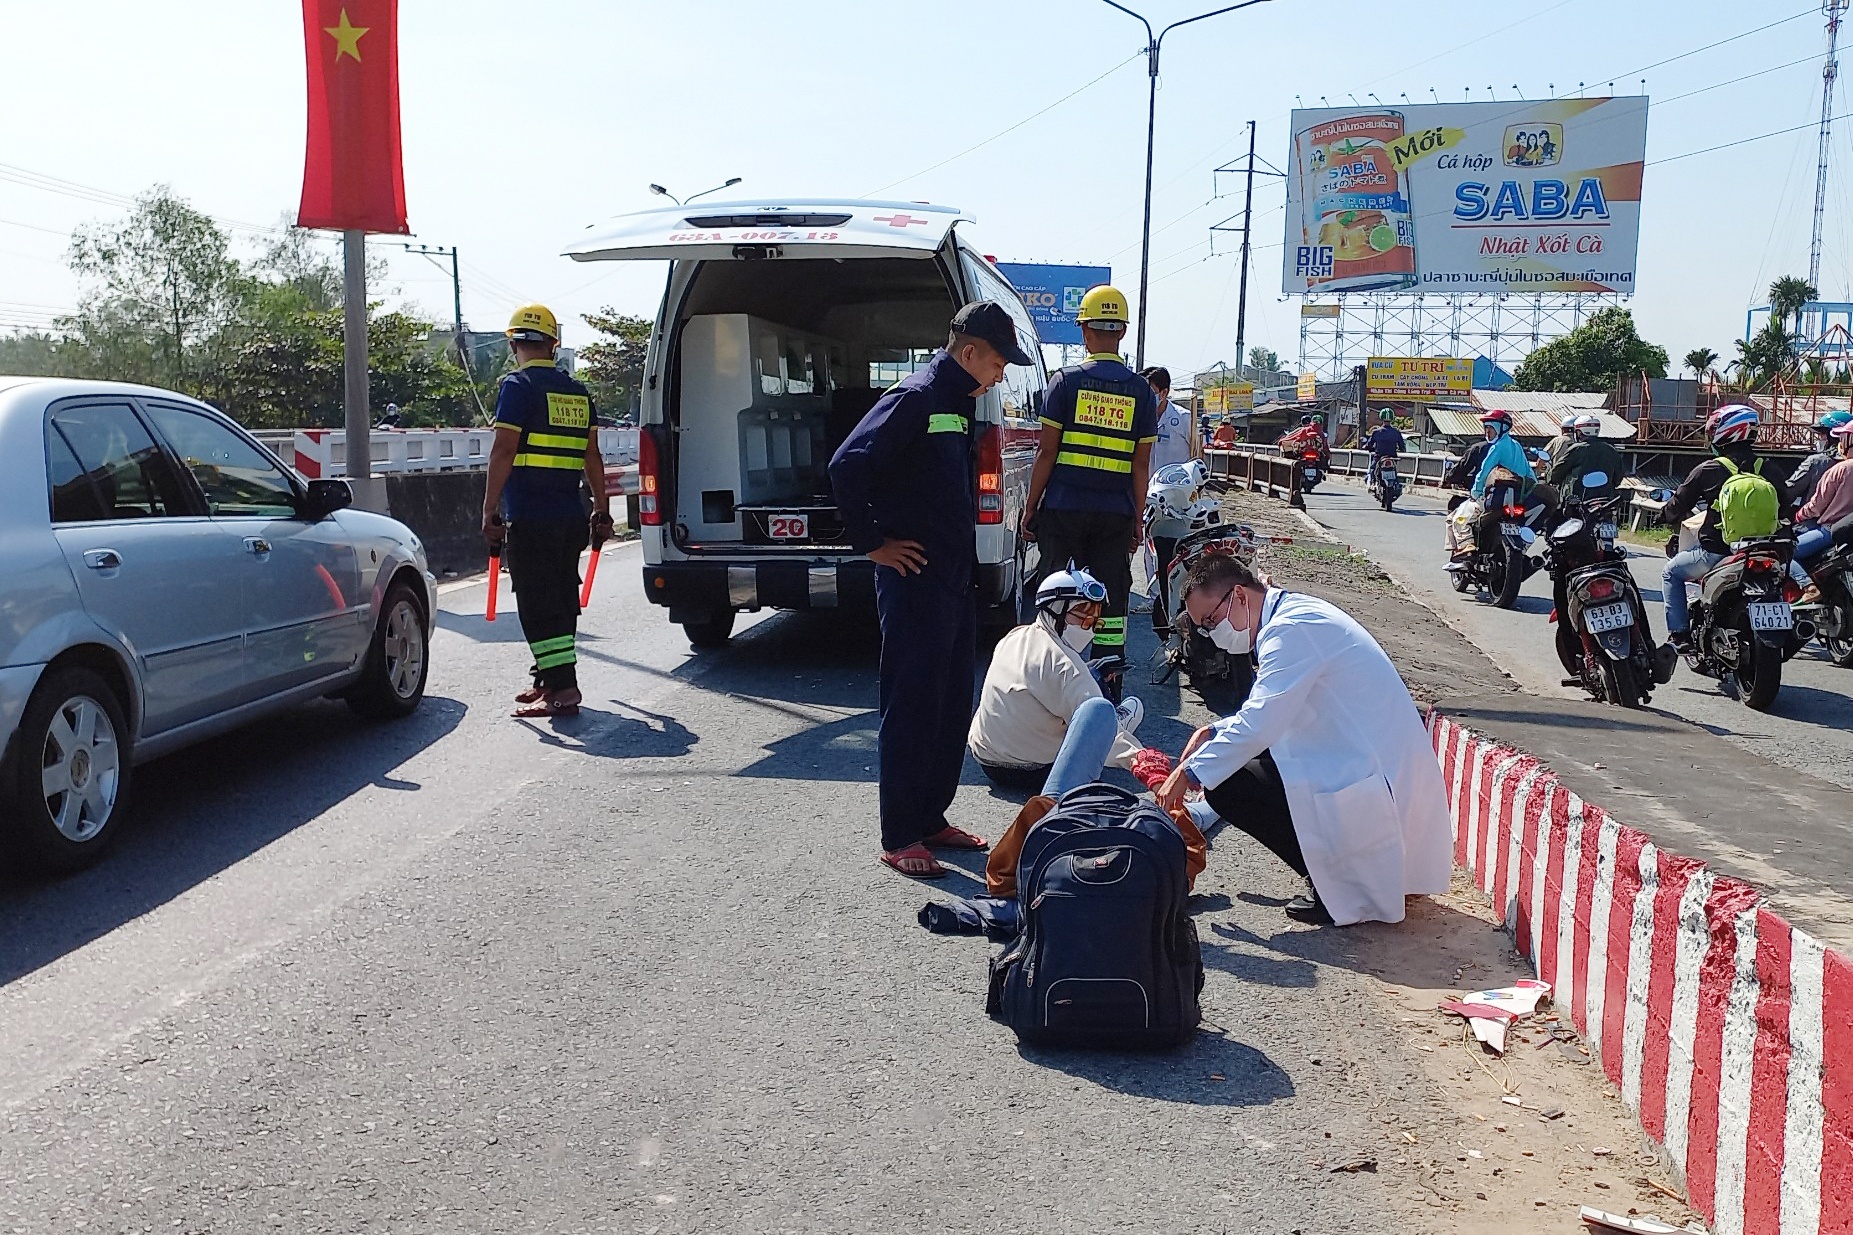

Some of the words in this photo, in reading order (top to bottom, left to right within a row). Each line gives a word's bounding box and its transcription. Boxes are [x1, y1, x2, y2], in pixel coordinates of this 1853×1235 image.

[1393, 127, 1446, 165] Mới
[1328, 161, 1378, 179] SABA
[1437, 154, 1458, 169] Cá
[1462, 154, 1493, 171] hộp
[1453, 177, 1610, 221] SABA
[1479, 234, 1530, 258] Nhật
[1535, 232, 1571, 254] Xốt
[1576, 234, 1603, 254] Cà
[1296, 246, 1334, 266] BIG
[1295, 266, 1332, 277] FISH
[1401, 361, 1420, 372] TƯ
[1421, 360, 1445, 373] TRÍ
[556, 406, 570, 417] 118
[1087, 404, 1105, 417] 118
[1109, 407, 1125, 420] TG
[771, 518, 805, 537] 20
[1755, 605, 1784, 616] 71-C1
[1590, 614, 1628, 631] 135.67
[1754, 617, 1789, 628] 640.21
